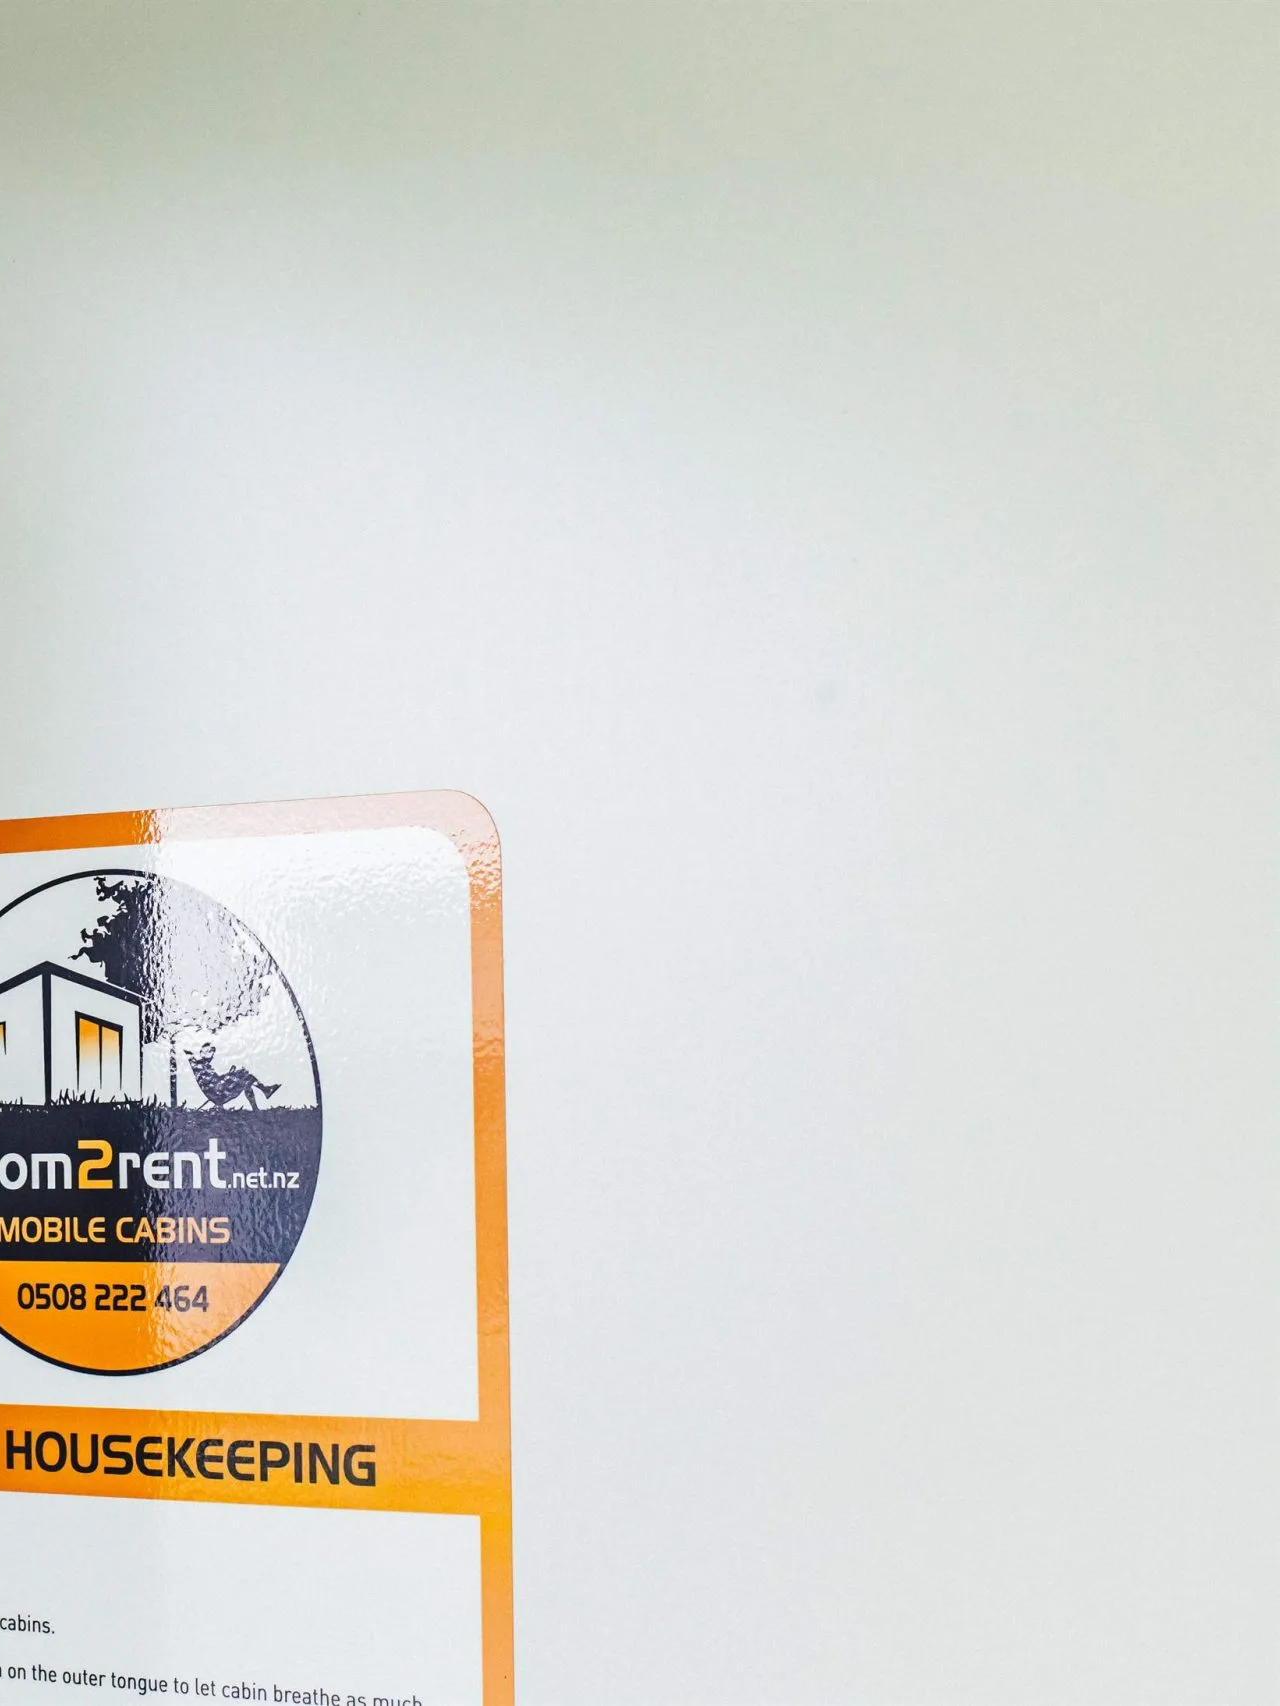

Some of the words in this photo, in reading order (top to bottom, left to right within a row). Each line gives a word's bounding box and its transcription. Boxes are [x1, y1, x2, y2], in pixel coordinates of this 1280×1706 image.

[116, 1216, 230, 1244] CABINS
[17, 1283, 87, 1310] 0508
[95, 1284, 147, 1311] 222
[155, 1285, 209, 1312] 464
[5, 1430, 376, 1487] HOUSEKEEPING
[0, 1614, 55, 1634] cabins.
[7, 1666, 26, 1680] on
[32, 1664, 57, 1683] the
[62, 1670, 106, 1687] outer
[111, 1672, 168, 1695] tongue
[173, 1677, 189, 1694] to
[195, 1678, 216, 1697] let
[222, 1682, 267, 1701] cabin
[274, 1684, 341, 1706] breathe
[346, 1695, 367, 1706] as
